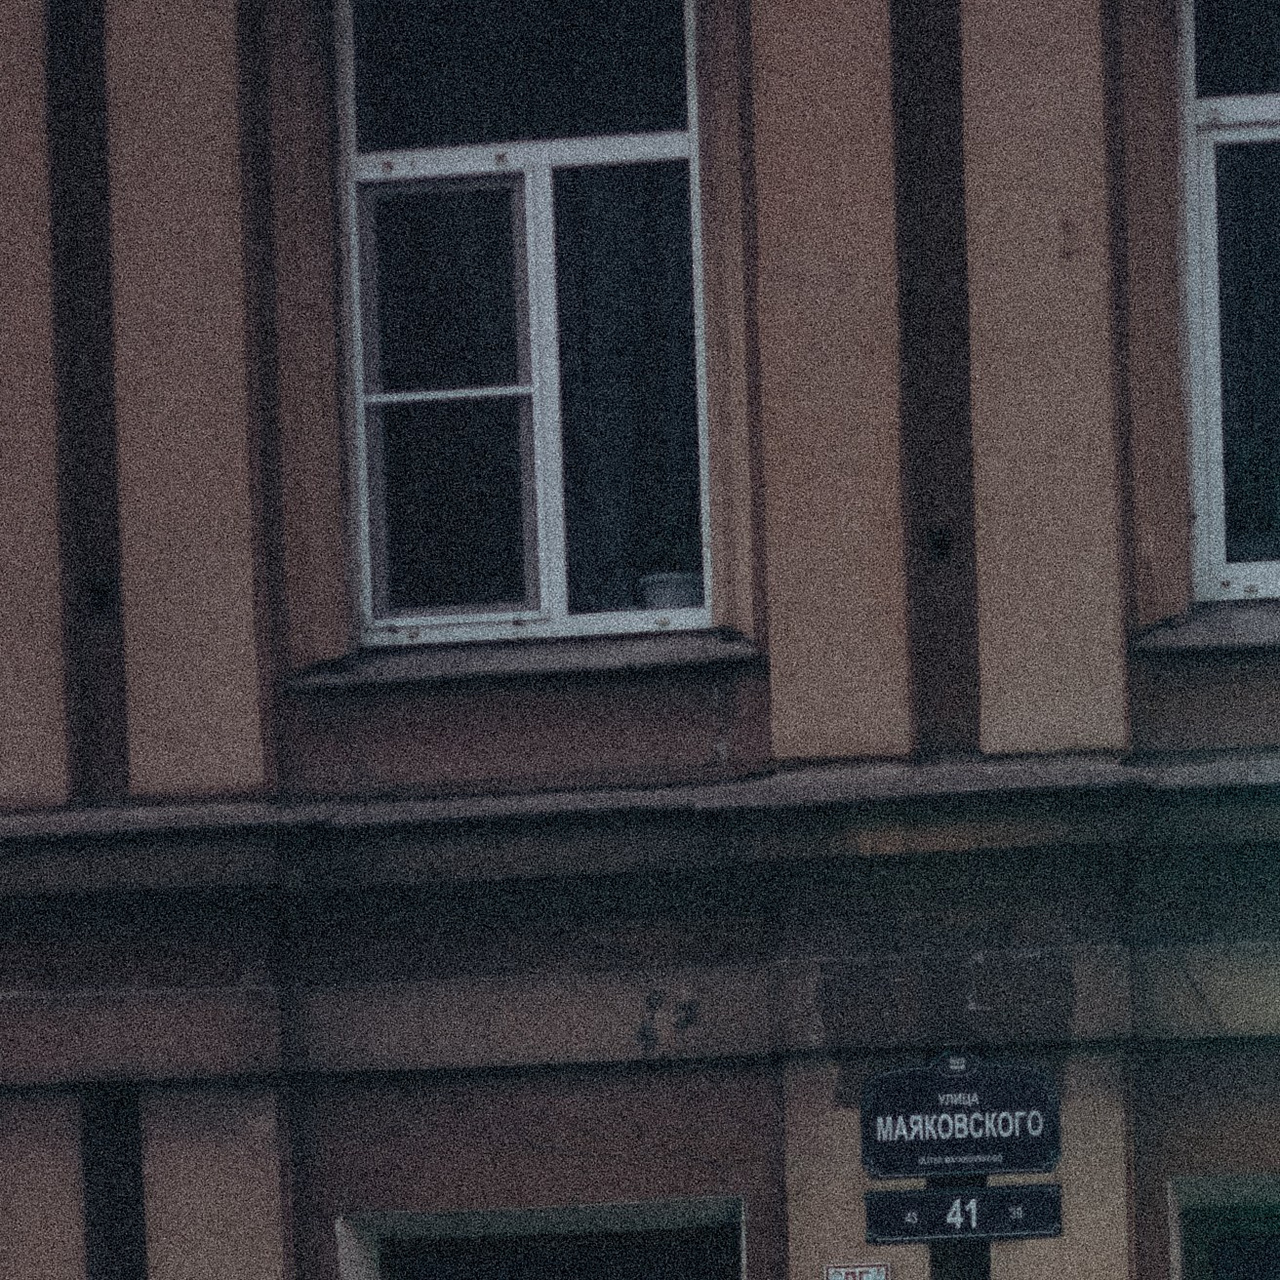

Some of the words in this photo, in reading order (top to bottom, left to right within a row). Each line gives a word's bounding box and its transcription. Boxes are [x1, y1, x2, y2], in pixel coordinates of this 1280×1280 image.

[937, 1092, 979, 1106] УЛИЦА
[876, 1110, 1044, 1142] МАЯКОВСКОГО
[946, 1198, 979, 1229] 41
